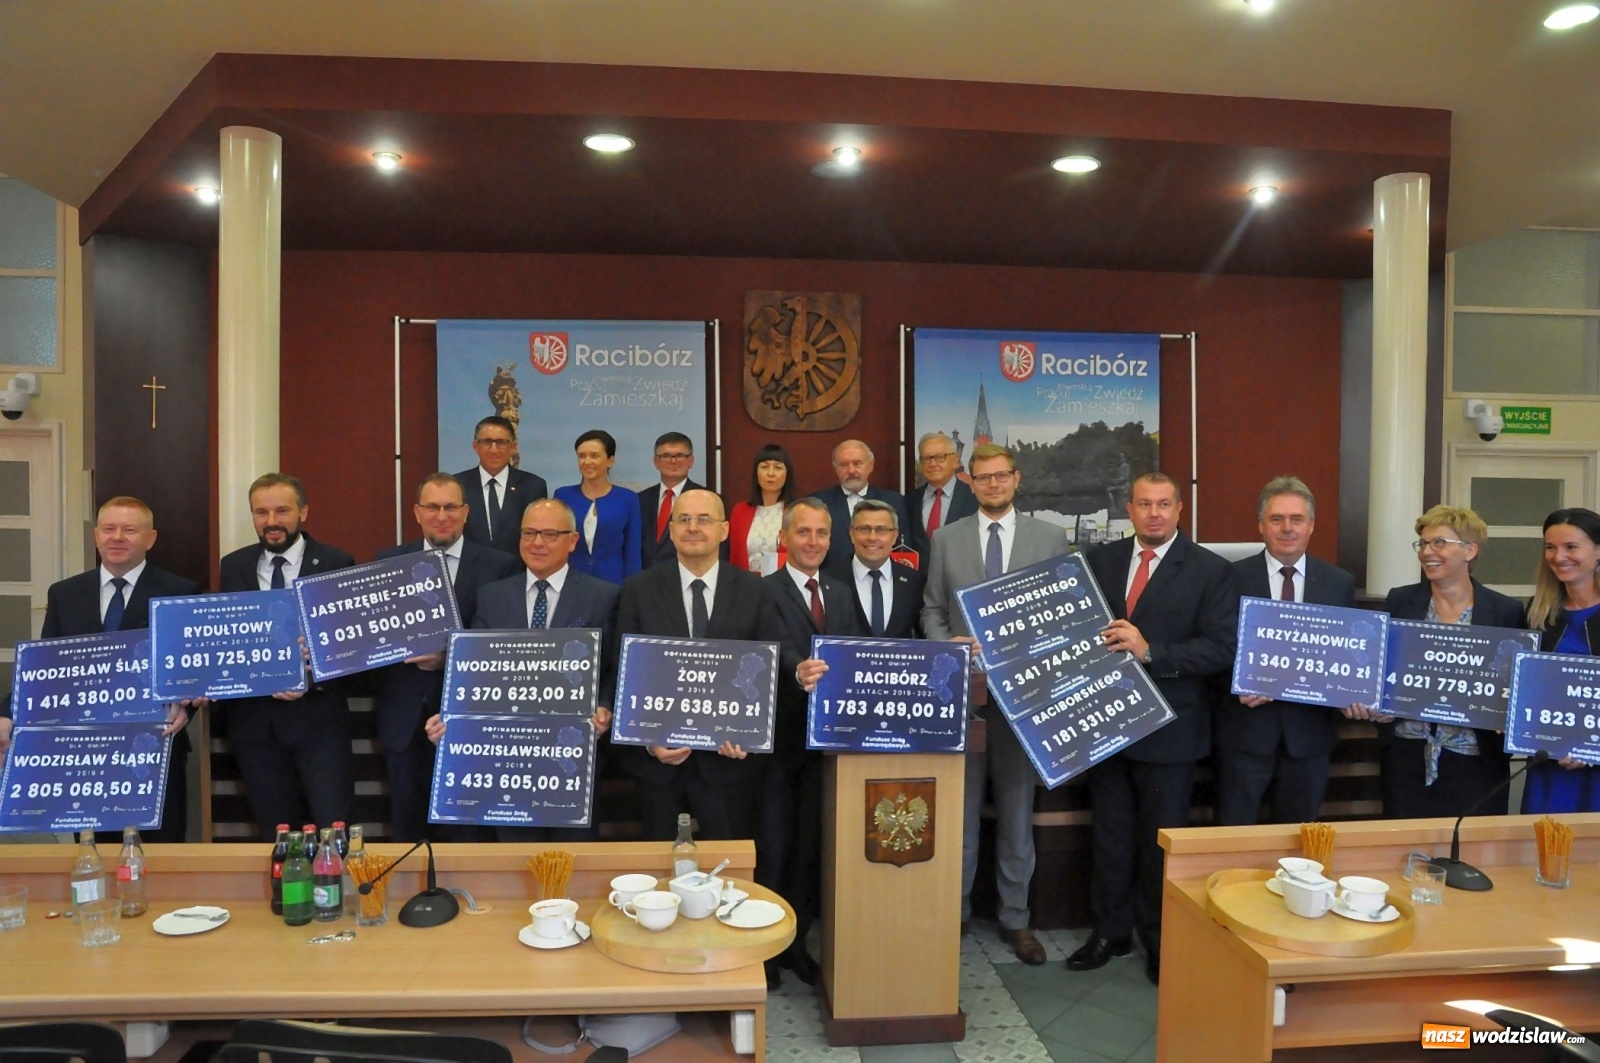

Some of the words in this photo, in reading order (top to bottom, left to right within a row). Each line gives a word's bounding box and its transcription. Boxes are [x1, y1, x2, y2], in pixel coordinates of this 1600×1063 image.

[575, 342, 693, 367] Racibórz
[1041, 352, 1148, 376] Racibórz
[580, 389, 683, 410] Zamieszkaj
[1045, 397, 1139, 416] Zamieszkaj
[1505, 410, 1547, 420] WYJŚCIE
[309, 577, 443, 618] JASTRZĘBIE-ZDRÓJ
[978, 577, 1078, 618] RACIBORSKIEGO
[184, 620, 273, 638] RYDUŁTOWY
[318, 631, 330, 646] 3
[334, 624, 363, 641] 031
[369, 609, 426, 634] 500,00
[431, 605, 446, 620] zł
[984, 630, 995, 643] 2
[999, 619, 1025, 638] 476
[1029, 602, 1075, 627] 210,20
[1079, 596, 1092, 610] zł
[1257, 627, 1367, 650] KRZYŻANOWICE
[165, 655, 175, 670] 3
[181, 652, 210, 667] 081
[216, 648, 272, 666] 725,90
[278, 646, 292, 661] zł
[456, 660, 591, 672] WODZISŁAWSKIEGO
[1002, 680, 1013, 693] 2
[1015, 665, 1041, 686] 341
[1042, 640, 1091, 672] 744,20
[1248, 652, 1254, 665] 1
[1260, 653, 1290, 669] 340
[1296, 658, 1350, 677] 783,40
[1357, 666, 1371, 679] zł
[1424, 650, 1485, 667] GODÓW
[22, 663, 111, 682] WODZISŁAW
[115, 658, 149, 674] ŚLĄS
[678, 667, 717, 683] ŻORY
[855, 670, 928, 686] RACIBÓRZ
[1561, 667, 1600, 675] DOFINAN
[456, 687, 465, 700] 3
[471, 687, 501, 701] 370
[508, 686, 564, 703] 623,00
[570, 686, 585, 700] zł
[1386, 672, 1397, 684] 4
[1403, 674, 1430, 689] 021
[1437, 677, 1495, 697] 779,30
[1501, 688, 1510, 698] z
[1566, 684, 1600, 699] MSZ
[26, 697, 33, 711] 1
[40, 694, 71, 709] 414
[77, 687, 136, 705] 380,00
[142, 688, 150, 699] z
[630, 695, 637, 709] 1
[643, 696, 675, 712] 367
[680, 698, 739, 717] 638,50
[745, 702, 761, 717] zł
[1032, 670, 1122, 726] RACIBORSKIEGO
[823, 700, 829, 714] 1
[837, 700, 867, 716] 783
[874, 702, 934, 720] 489,00
[940, 704, 955, 718] zł
[1525, 708, 1532, 721] 1
[1539, 710, 1576, 727] 823
[1041, 740, 1052, 752] 1
[1052, 726, 1076, 747] 181
[1078, 699, 1125, 732] 331,60
[1127, 690, 1142, 706] zł
[14, 753, 107, 767] WODZISŁAW
[111, 750, 161, 767] ŚLĄSKI
[449, 743, 583, 758] WODZISŁAWSKIEGO
[10, 783, 22, 799] 2
[27, 782, 63, 798] 805
[69, 780, 132, 798] 068,50
[137, 780, 153, 795] zł
[445, 772, 455, 787] 3
[461, 773, 493, 788] 433
[499, 774, 559, 792] 605,00
[565, 776, 580, 790] zł
